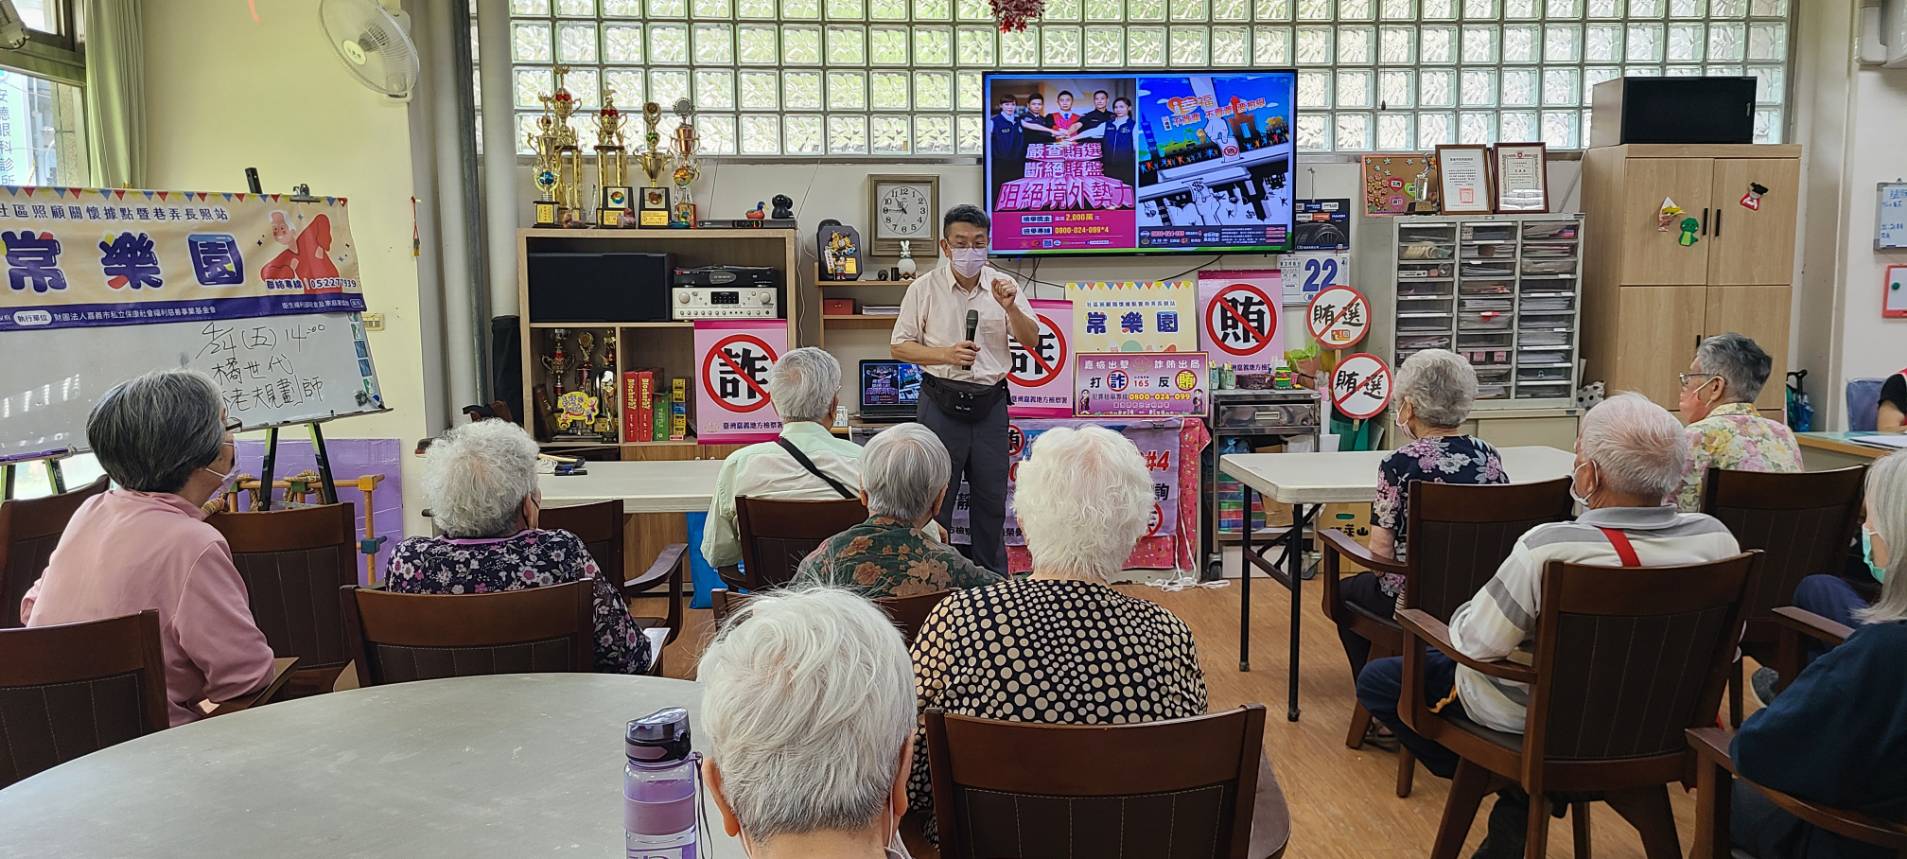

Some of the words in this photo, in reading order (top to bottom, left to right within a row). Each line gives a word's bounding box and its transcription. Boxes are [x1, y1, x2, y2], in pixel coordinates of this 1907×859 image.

[1026, 143, 1103, 159] 嚴查賄選
[995, 181, 1134, 211] 阻絕境外勢力
[0, 230, 246, 293] 常樂園
[1303, 258, 1338, 291] 22
[1086, 311, 1178, 334] 常樂園
[1219, 295, 1266, 343] 賄
[1313, 302, 1364, 327] 賄選
[717, 347, 769, 400] 詐
[1335, 370, 1384, 400] 賄選
